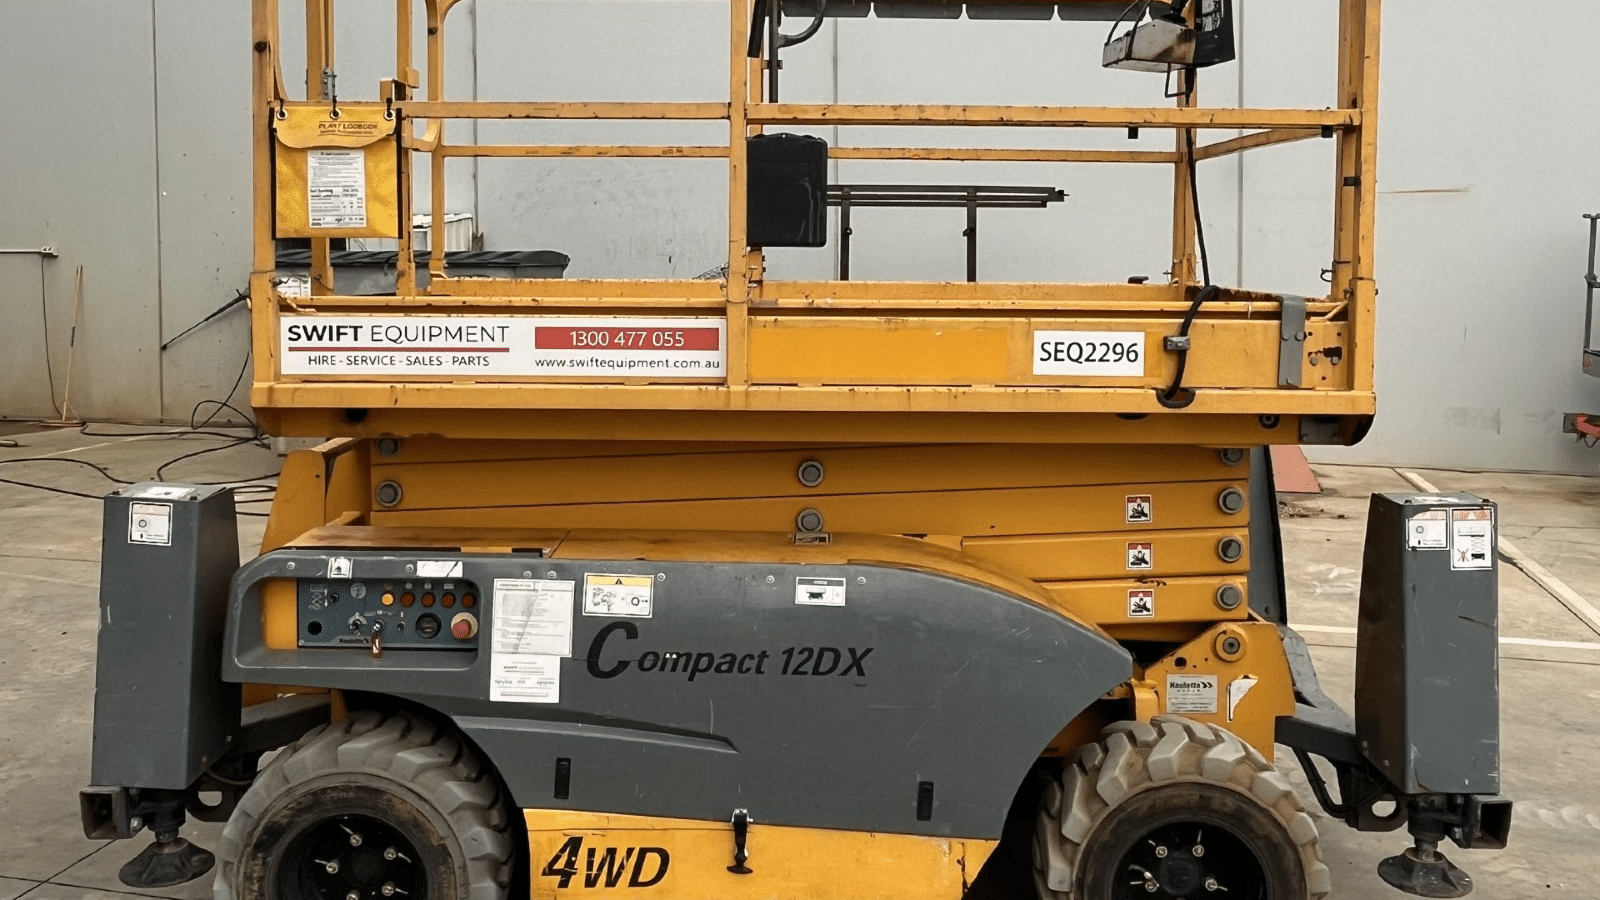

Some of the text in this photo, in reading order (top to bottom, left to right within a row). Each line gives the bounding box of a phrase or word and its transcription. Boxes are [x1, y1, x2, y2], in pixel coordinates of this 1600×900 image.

[288, 325, 510, 344] SWIFT EQUIPMENT
[570, 331, 685, 347] 1300 477 055
[308, 355, 337, 366] HIRE
[346, 355, 396, 366] SERVICE
[406, 355, 443, 366] SALES
[452, 356, 490, 367] PARTS
[1040, 342, 1139, 364] SEQ2296
[535, 357, 720, 370] www.swiftequipment.com.au
[586, 620, 770, 682] Compact
[781, 647, 874, 677] 12DX
[541, 836, 670, 889] 4WD
